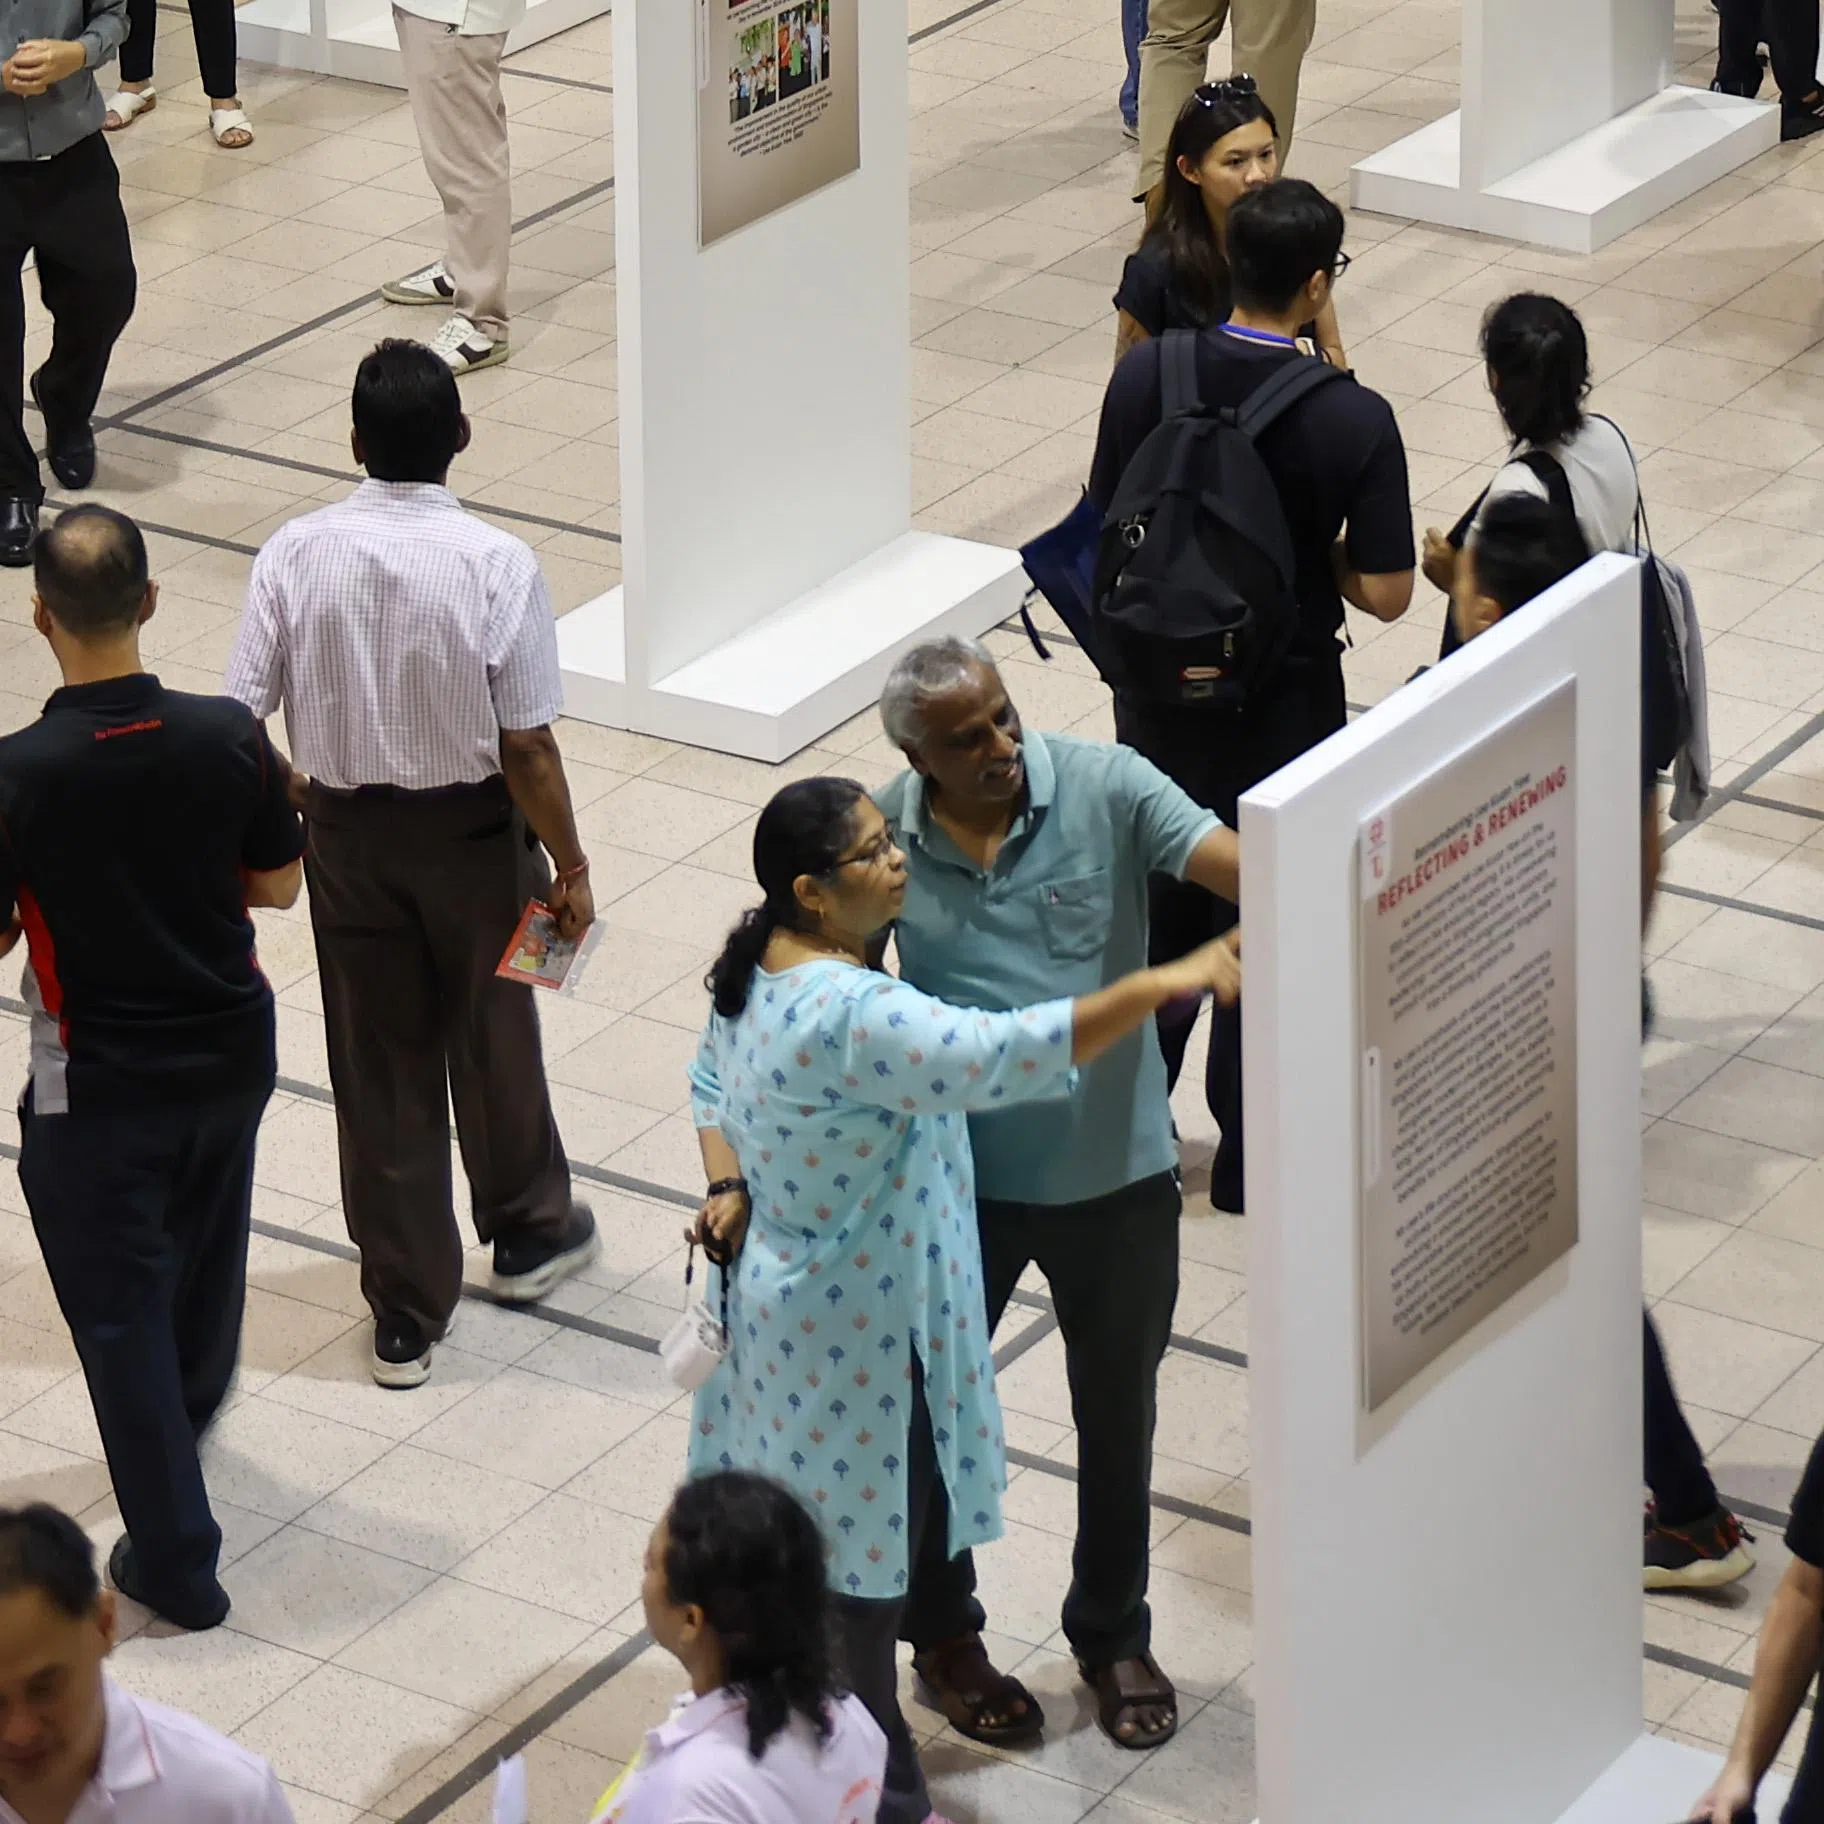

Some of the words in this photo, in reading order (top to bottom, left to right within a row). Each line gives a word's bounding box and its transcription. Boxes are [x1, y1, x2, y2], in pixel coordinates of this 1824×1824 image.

[1377, 831, 1469, 915] REFLECTING
[1473, 821, 1484, 847] &
[1488, 762, 1566, 837] RENEWING
